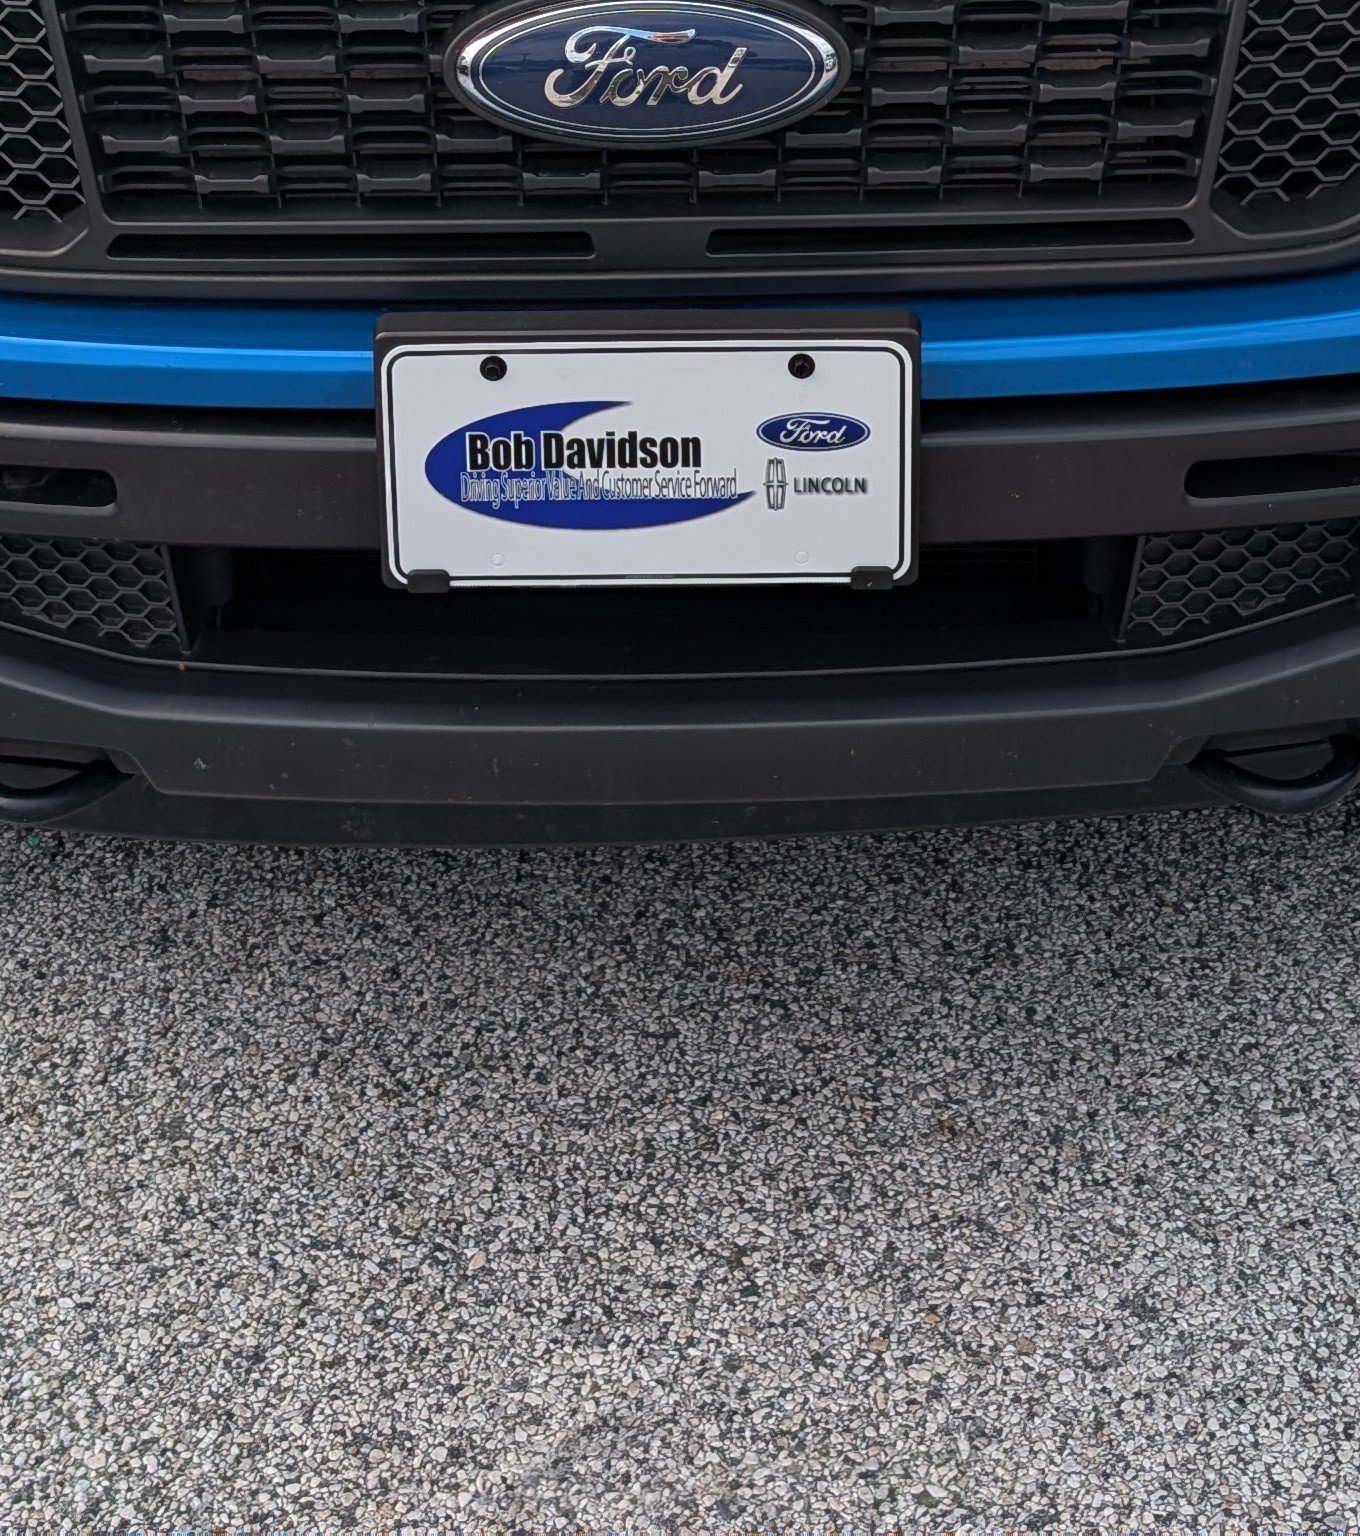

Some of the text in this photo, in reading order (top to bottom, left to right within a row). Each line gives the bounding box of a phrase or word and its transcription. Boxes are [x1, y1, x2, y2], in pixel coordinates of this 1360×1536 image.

[544, 25, 748, 107] Ford
[467, 430, 702, 471] Bob Davidson
[779, 417, 848, 444] Ford
[460, 467, 738, 509] Driving Superior Value And Customer Service Forward
[793, 476, 868, 495] LINCOLN
